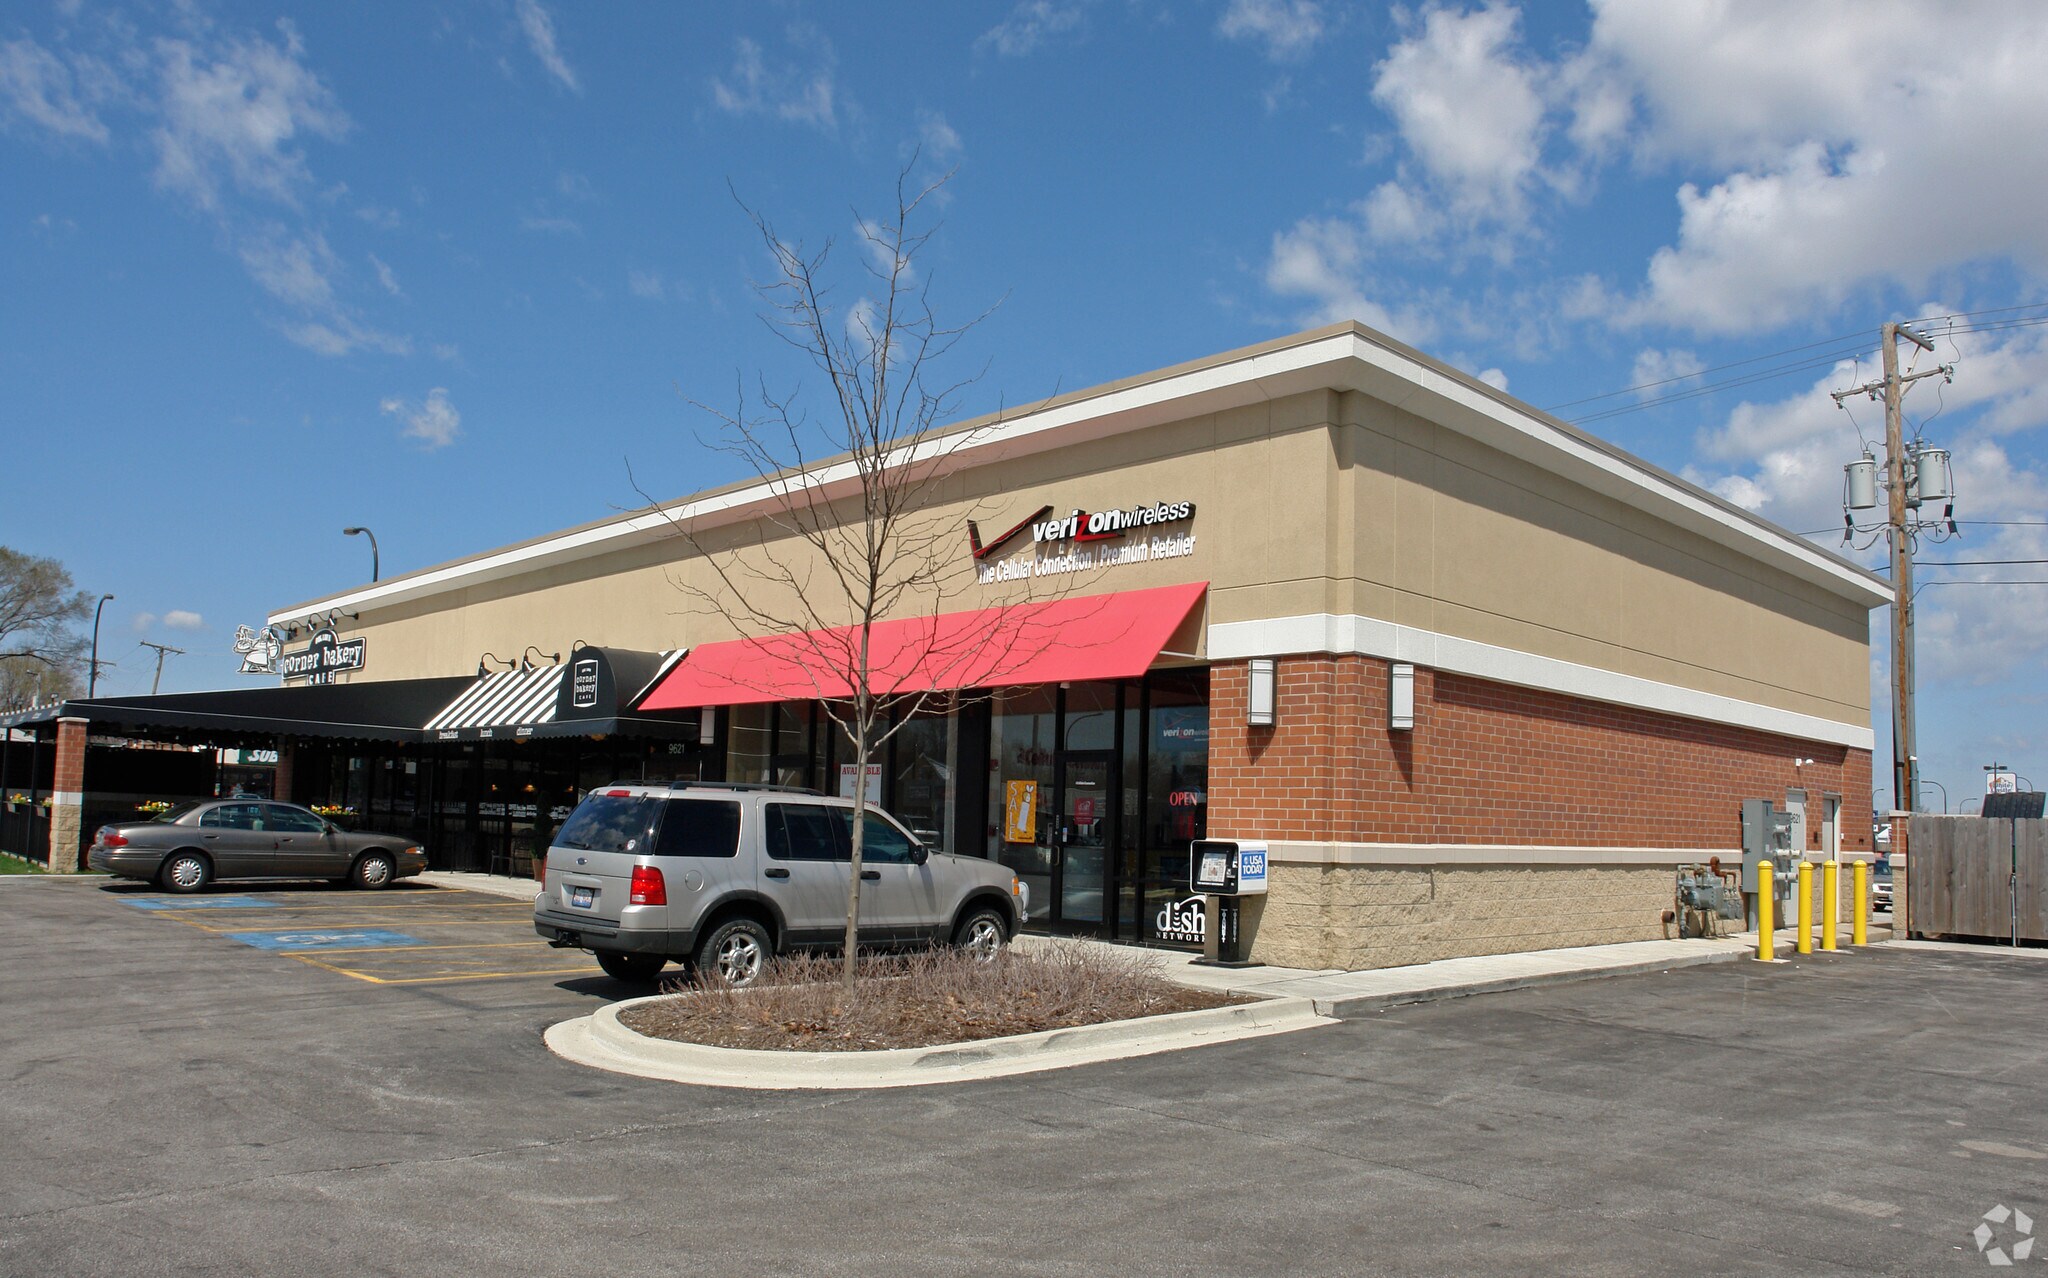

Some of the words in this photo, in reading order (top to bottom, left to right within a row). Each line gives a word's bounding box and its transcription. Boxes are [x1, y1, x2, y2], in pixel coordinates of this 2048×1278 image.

[978, 564, 995, 585] The
[996, 559, 1033, 583] Cellular
[1034, 551, 1092, 577] Connection
[1099, 541, 1148, 568] Premium
[1150, 532, 1197, 560] Retailer
[284, 652, 319, 674] corner
[323, 645, 363, 667] bakery
[309, 671, 333, 685] CAFE
[668, 743, 685, 754] 9621
[841, 766, 881, 776] AVAIBLE
[1169, 791, 1198, 807] OPEN
[1008, 781, 1019, 841] SALE
[1249, 855, 1263, 865] USA
[1242, 864, 1264, 875] TODAY
[1156, 901, 1206, 934] dish
